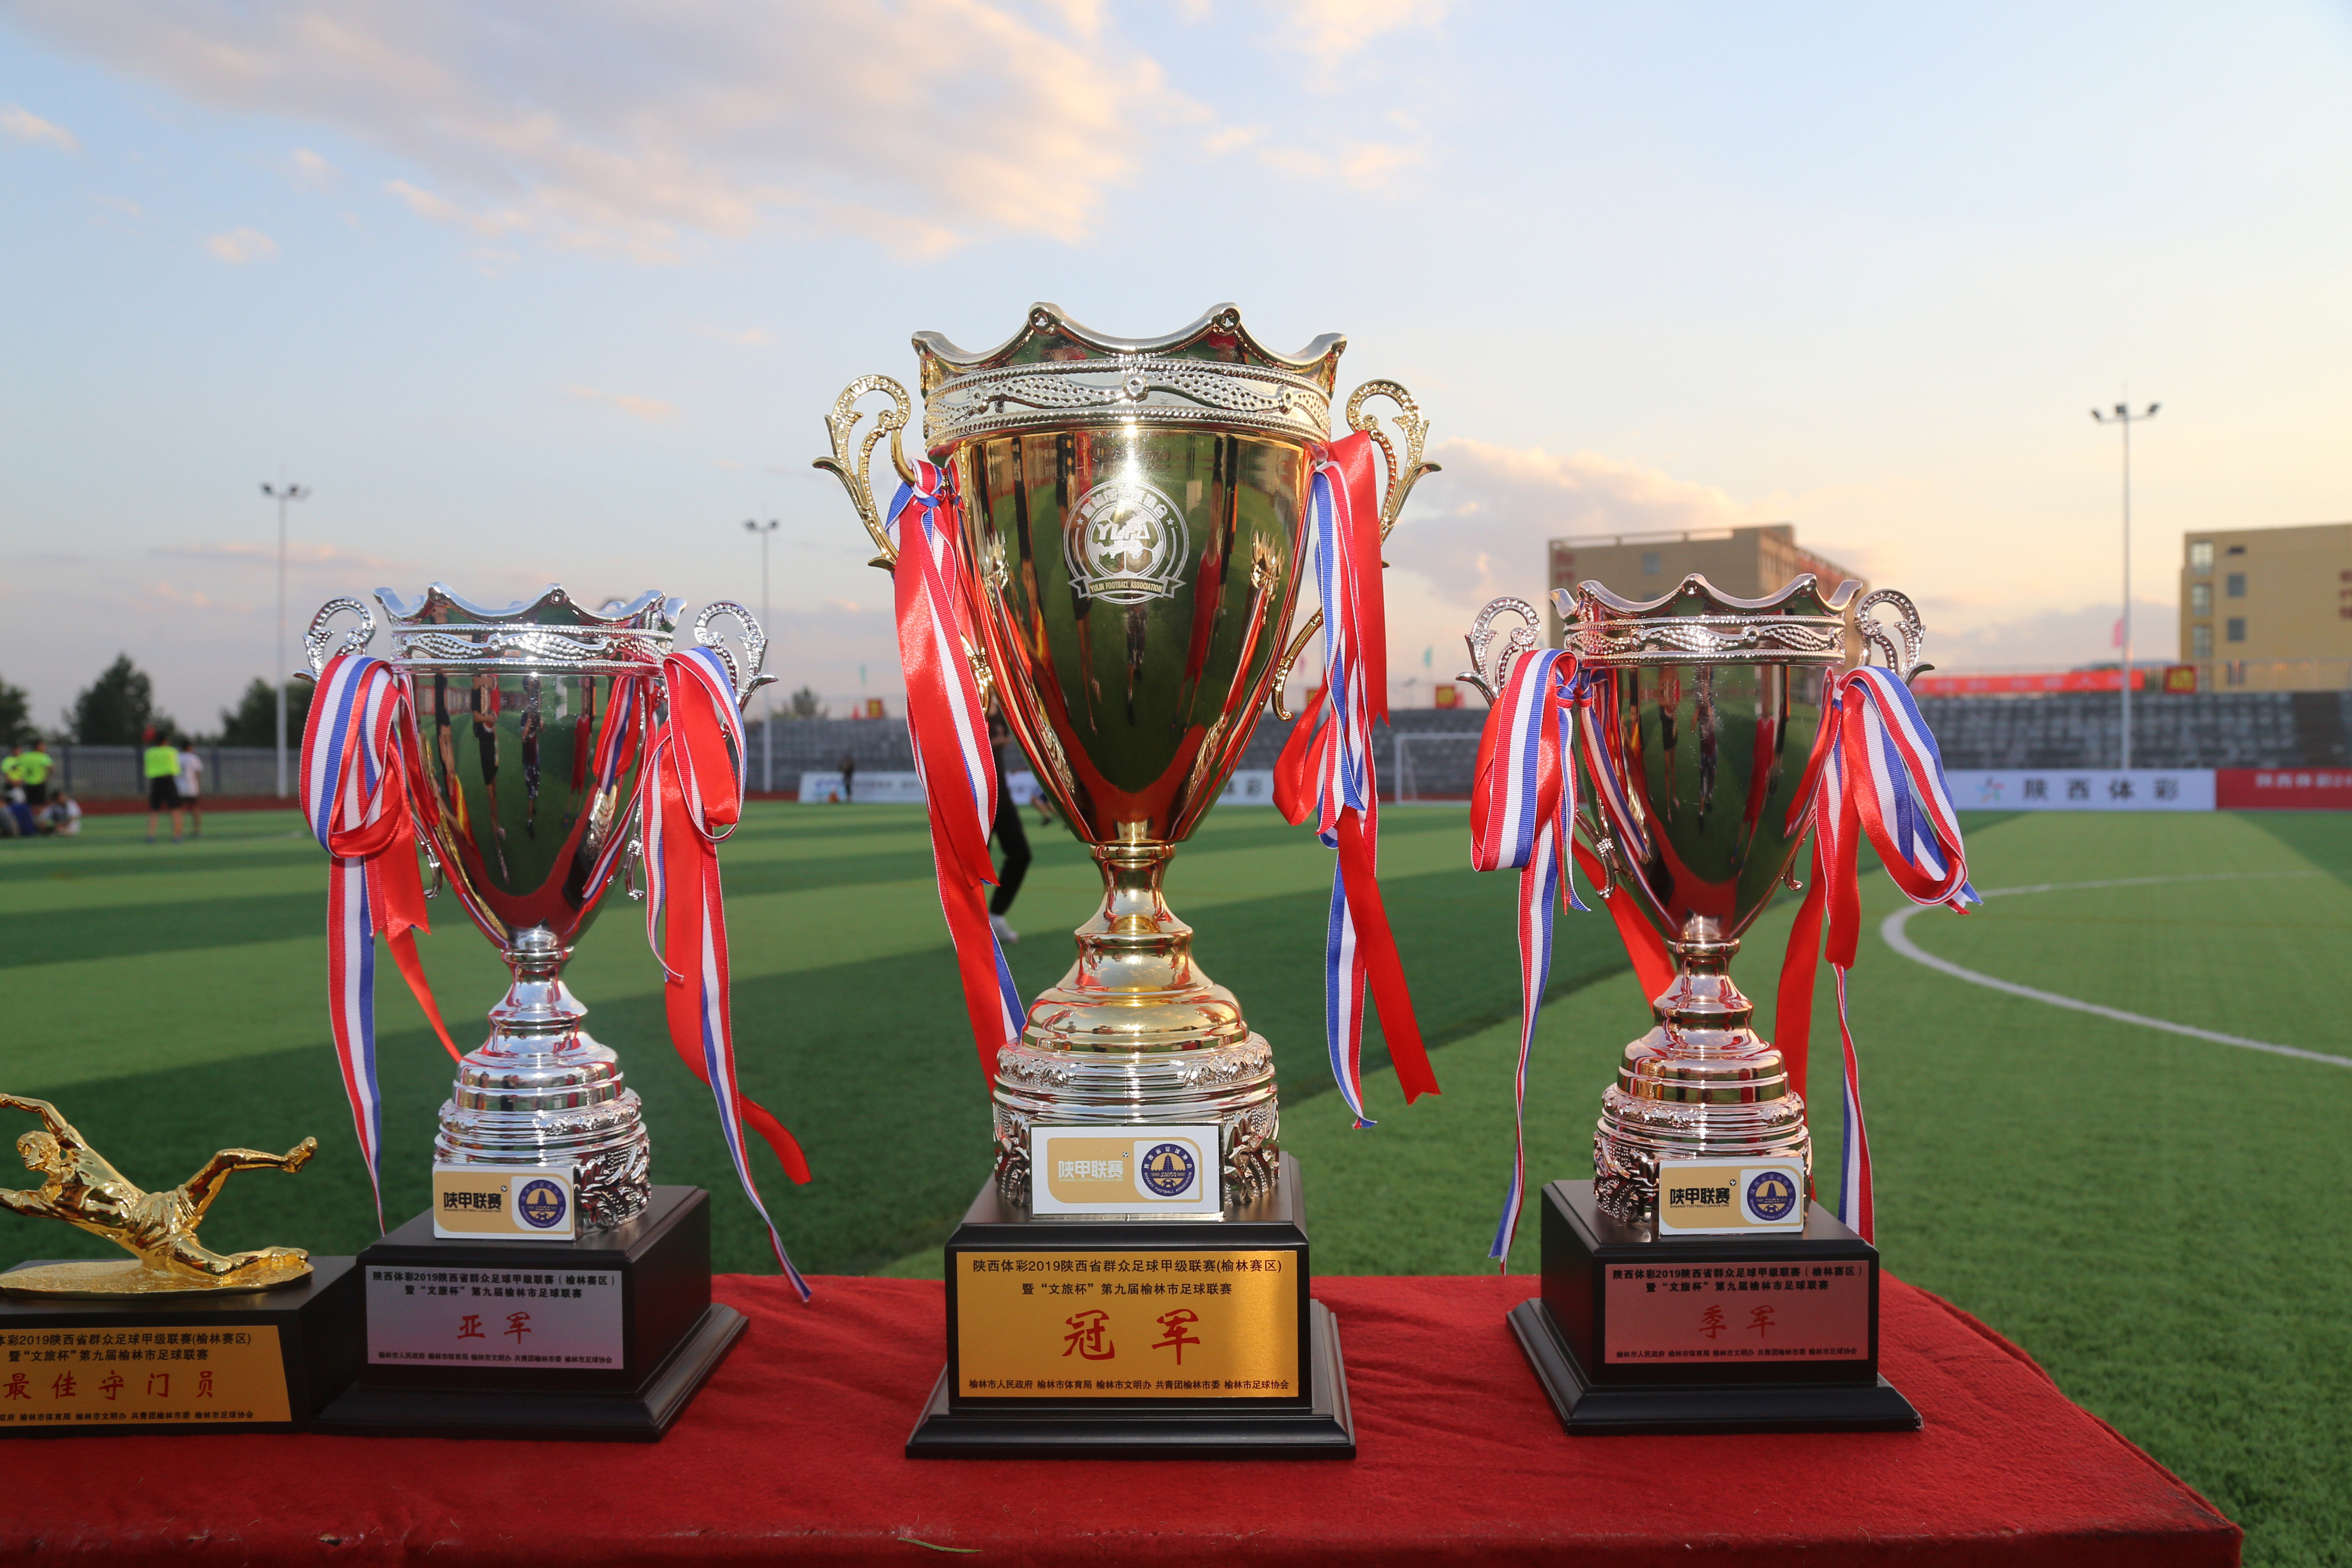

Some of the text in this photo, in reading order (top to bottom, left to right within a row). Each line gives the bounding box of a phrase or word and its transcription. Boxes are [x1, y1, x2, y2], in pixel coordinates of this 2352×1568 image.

[1090, 581, 1163, 593] YULIN FOOTBALL ASSOCIATION
[1058, 1161, 1124, 1178] 陕甲联赛
[444, 1192, 501, 1209] 陕甲联赛
[1670, 1188, 1730, 1204] 陕甲联赛
[973, 1259, 1282, 1273] 陕西体彩2019陕西省群众足球甲级联赛(榆林赛区)
[457, 1311, 532, 1344] 亚军
[1699, 1305, 1776, 1338] 季军
[1062, 1308, 1200, 1365] 冠军
[379, 1352, 426, 1360] 榆林市人民政府
[428, 1353, 469, 1361] 榆林市体育局
[564, 1355, 612, 1364] 榆林市足球协会
[1668, 1350, 1710, 1358] 榆林市体育局
[1809, 1347, 1858, 1356] 榆林市足球协会
[3, 1369, 214, 1400] 最佳守门员
[969, 1379, 1289, 1390] 榆林市人民政府 榆林市体育局 榆林市文明办 共青团榆林市委 榆林市足球协会
[20, 1413, 71, 1421] 榆林市体育局
[195, 1410, 254, 1419] 榆林市足球协会
